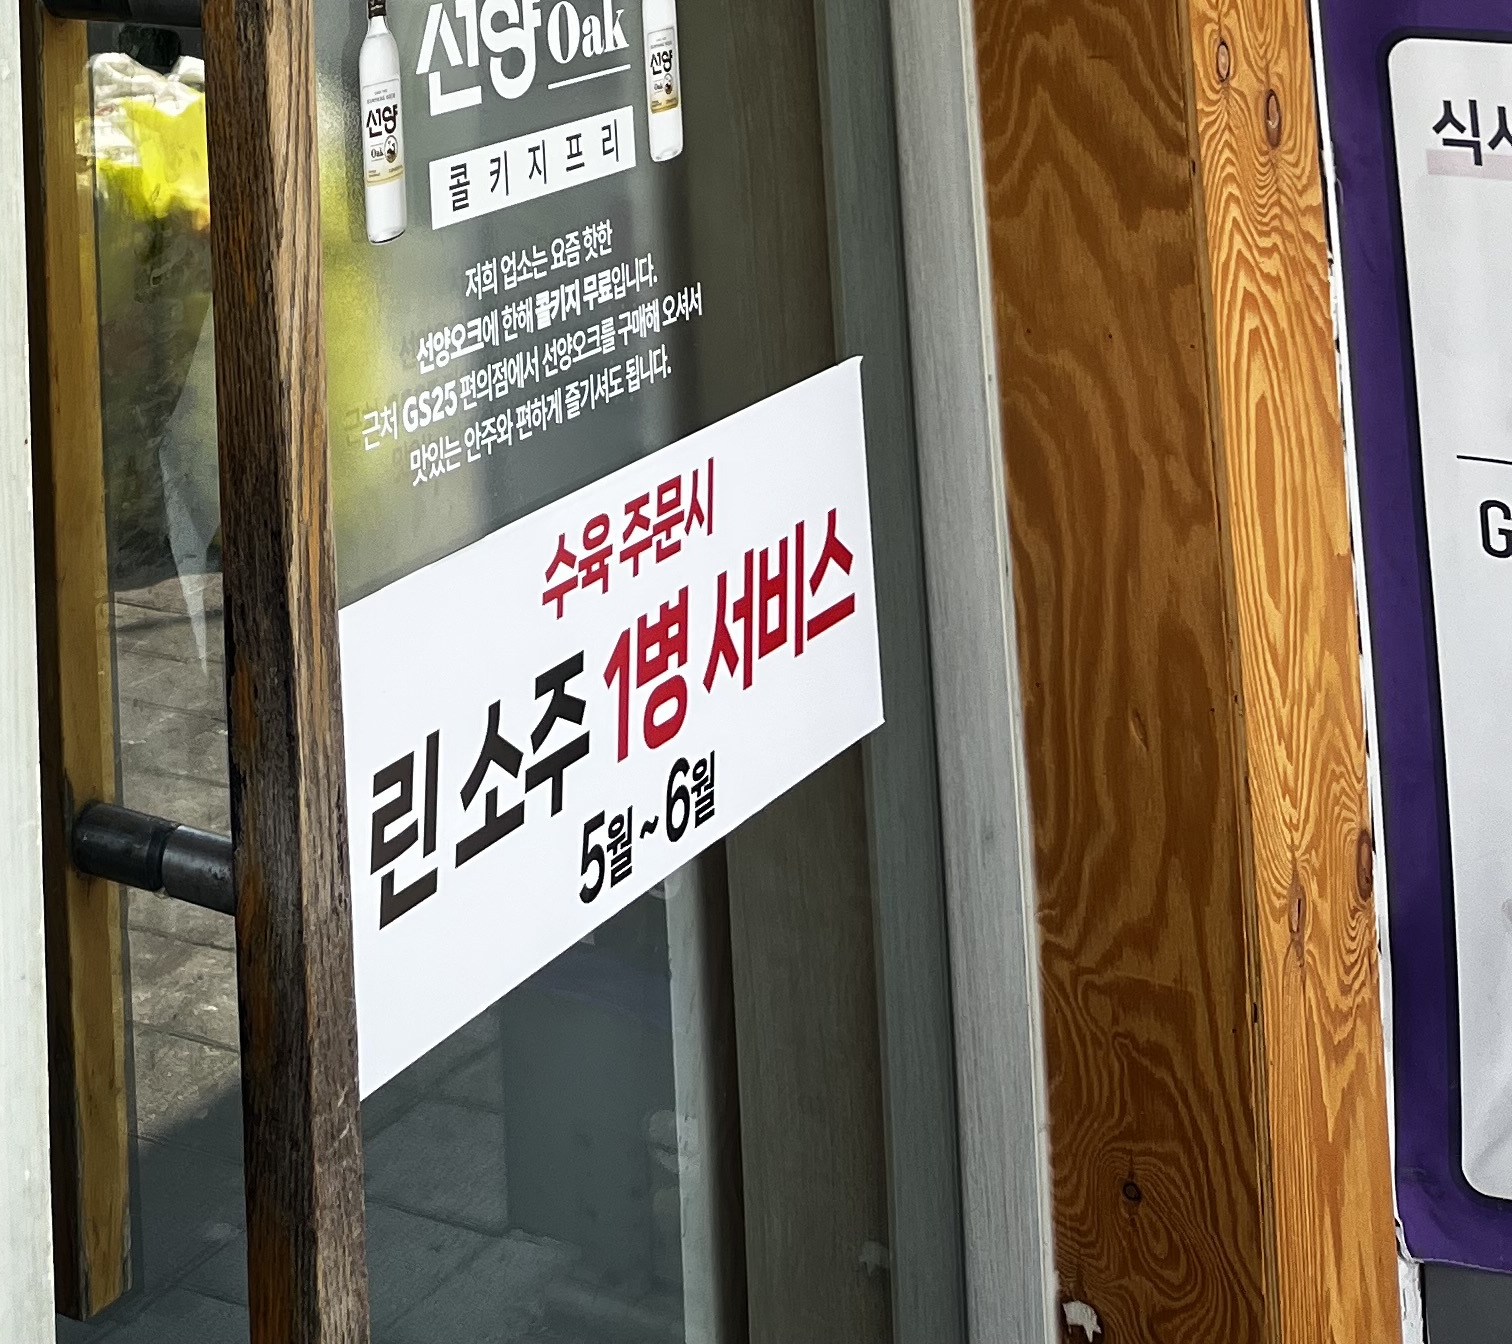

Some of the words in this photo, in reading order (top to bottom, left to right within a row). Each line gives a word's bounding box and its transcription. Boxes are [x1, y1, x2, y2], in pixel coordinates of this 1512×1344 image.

[370, 145, 384, 159] Oak
[415, 309, 500, 376] 선양오크에
[501, 298, 535, 341] 한해
[535, 278, 582, 330] 콜키지
[582, 252, 658, 305] 무료입니다.
[465, 262, 498, 301] 저희
[501, 244, 548, 291] 업소는
[550, 230, 581, 271] 요즘
[583, 219, 613, 261] 핫한
[361, 402, 399, 452] 근처
[402, 385, 459, 434] GS25
[459, 345, 540, 410] 편의점에서
[541, 316, 617, 378] 선양오크를
[616, 297, 661, 347] 구매해
[661, 282, 703, 327] 오셔서
[409, 435, 463, 487] 맛있는
[464, 416, 513, 464] 안주와
[515, 388, 564, 439] 편하게
[564, 361, 625, 420] 즐기셔도
[625, 343, 672, 392] 됩니다.
[542, 514, 613, 618] 수육
[619, 458, 715, 576] 주문시
[370, 729, 440, 931] 린
[454, 649, 591, 877] 소주
[602, 586, 689, 762] 1병
[702, 507, 857, 692] 서비스
[579, 749, 717, 905] 5월~6월
